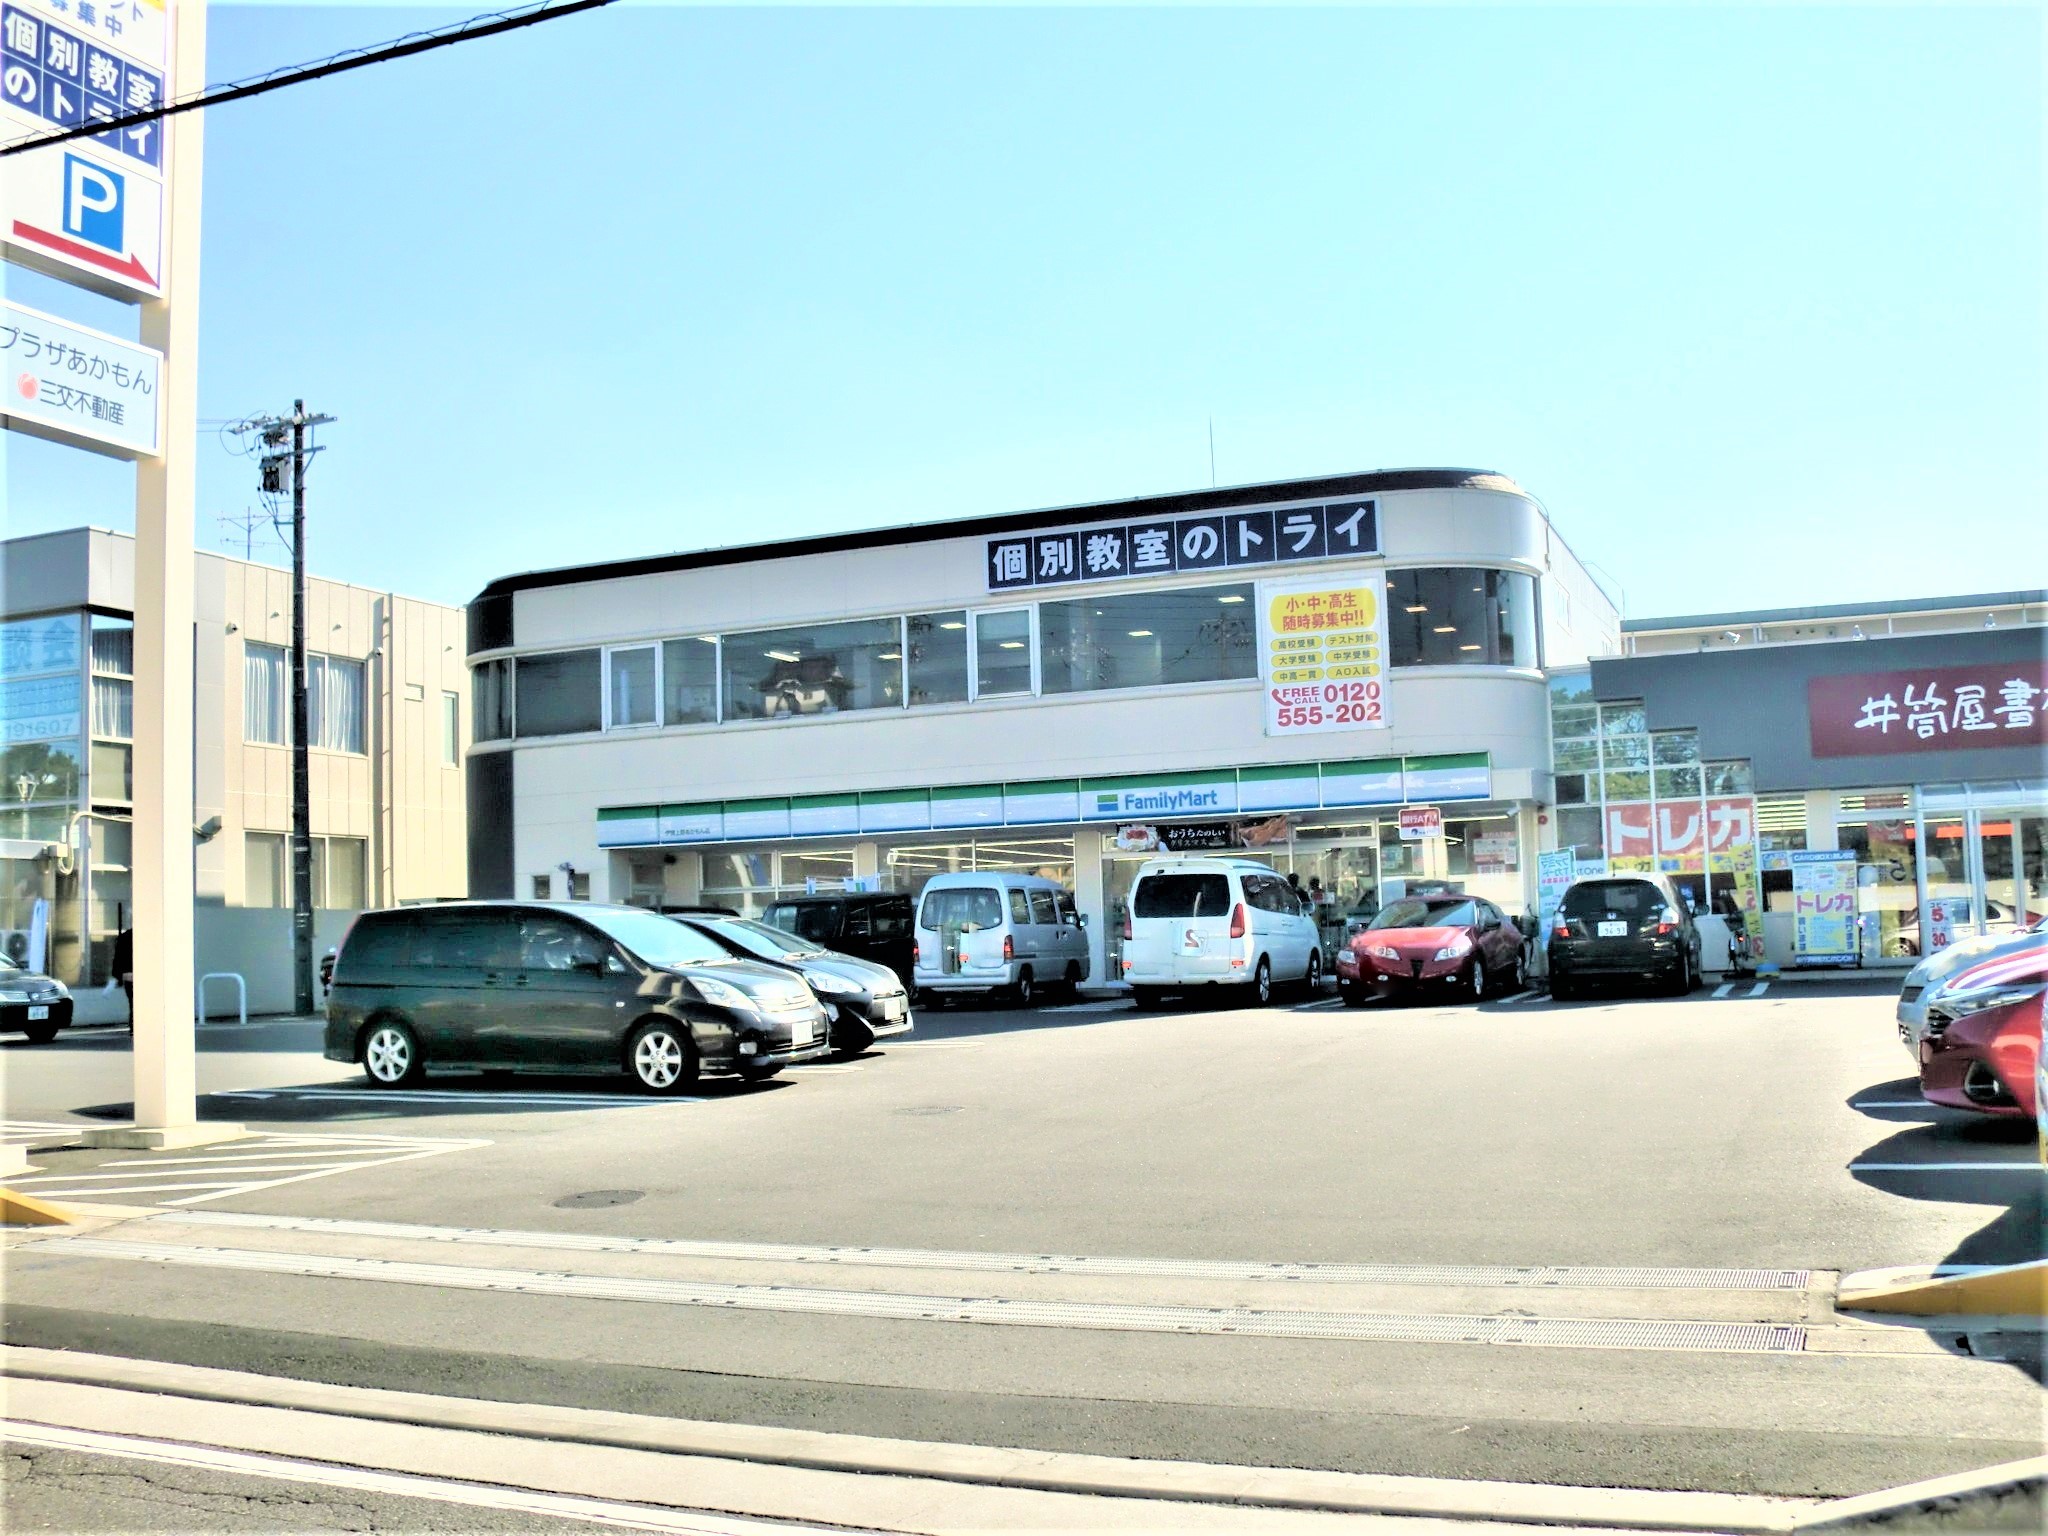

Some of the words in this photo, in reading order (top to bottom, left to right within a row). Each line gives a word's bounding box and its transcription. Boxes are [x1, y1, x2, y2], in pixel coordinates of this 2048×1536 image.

[4, 12, 156, 116] 個別教室
[4, 66, 152, 156] のトライ
[70, 160, 118, 232] P
[0, 326, 152, 395] プラザあかもん
[40, 379, 125, 426] 三交不動産
[993, 507, 1368, 582] 個別教室のトライ
[1282, 610, 1364, 631] 随時募集中!!
[1278, 638, 1316, 650] 高校受験
[1333, 649, 1371, 661] 中学受験
[1279, 653, 1316, 666] 大学受験
[1279, 669, 1317, 681] 中高一貫
[1335, 666, 1371, 677] AO入試
[1282, 686, 1320, 699] FREE
[1294, 696, 1321, 705] CALL
[1324, 681, 1381, 704] 0120
[1277, 702, 1382, 727] 555-202
[1854, 678, 2048, 739] 井筒屋書
[1125, 789, 1218, 811] FamilyMart
[1168, 828, 1226, 839] おうちたのしい
[1609, 804, 1751, 854] トレカ
[1796, 893, 1854, 914] トレカ
